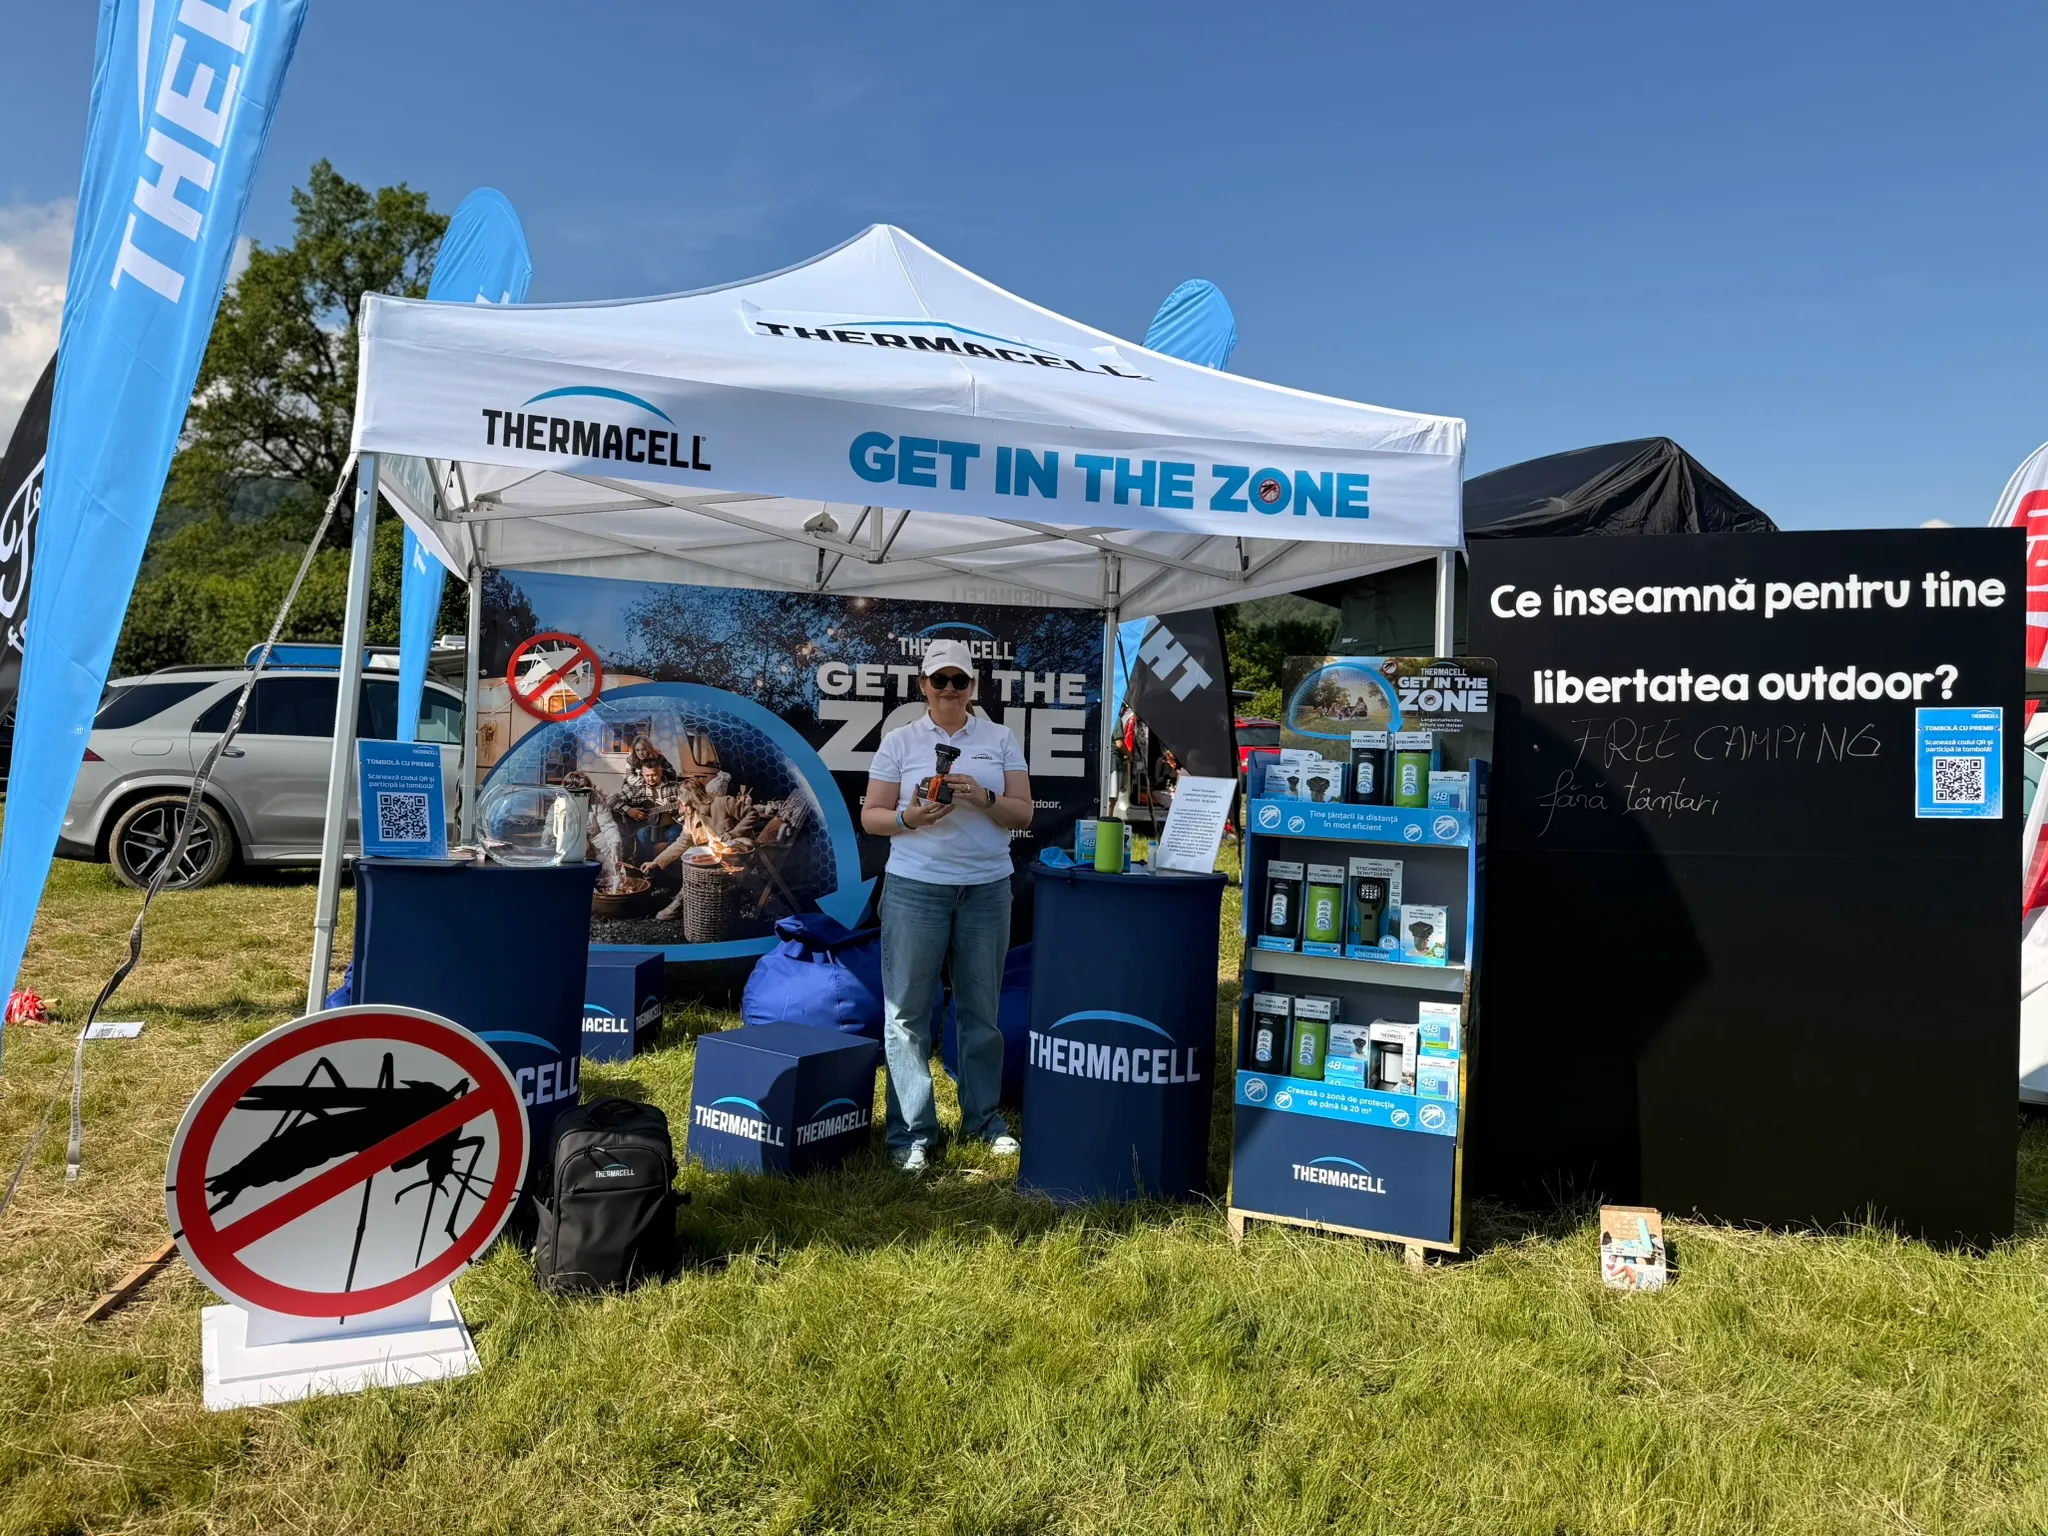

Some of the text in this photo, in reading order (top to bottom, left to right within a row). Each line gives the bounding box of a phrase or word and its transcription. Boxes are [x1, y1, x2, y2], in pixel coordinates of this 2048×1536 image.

[757, 321, 1150, 380] THERMACELL
[482, 409, 712, 471] THERMACELL
[849, 431, 1370, 519] GET IN THE ZONE
[1490, 584, 1542, 618] Ce
[1765, 576, 1910, 618] pentru
[1922, 570, 2006, 608] tine
[898, 637, 1014, 660] THEACELL
[816, 661, 919, 698] GET
[991, 670, 1086, 704] THE
[1398, 677, 1488, 689] GET IN THE
[1421, 668, 1467, 676] THERMACELL
[1533, 664, 1959, 704] libertatea outdoor?
[1398, 689, 1488, 712] ZONE
[1571, 717, 1681, 769] FREE
[1433, 792, 1448, 800] 48
[1352, 823, 1382, 831] eficient
[1083, 839, 1096, 847] 48
[1424, 1023, 1439, 1033] 48
[1029, 1030, 1200, 1084] THERMACELL
[1327, 1060, 1342, 1070] 48
[1421, 1077, 1436, 1086] 48
[1308, 1098, 1318, 1106] de
[1340, 1103, 1348, 1111] la
[1349, 1105, 1360, 1113] 20
[1347, 1095, 1358, 1103] de
[695, 1105, 785, 1147] THERMACELL
[796, 1108, 869, 1146] THERMACELL
[595, 1168, 635, 1178] THERMACELL
[1292, 1164, 1386, 1194] THERMACELL
